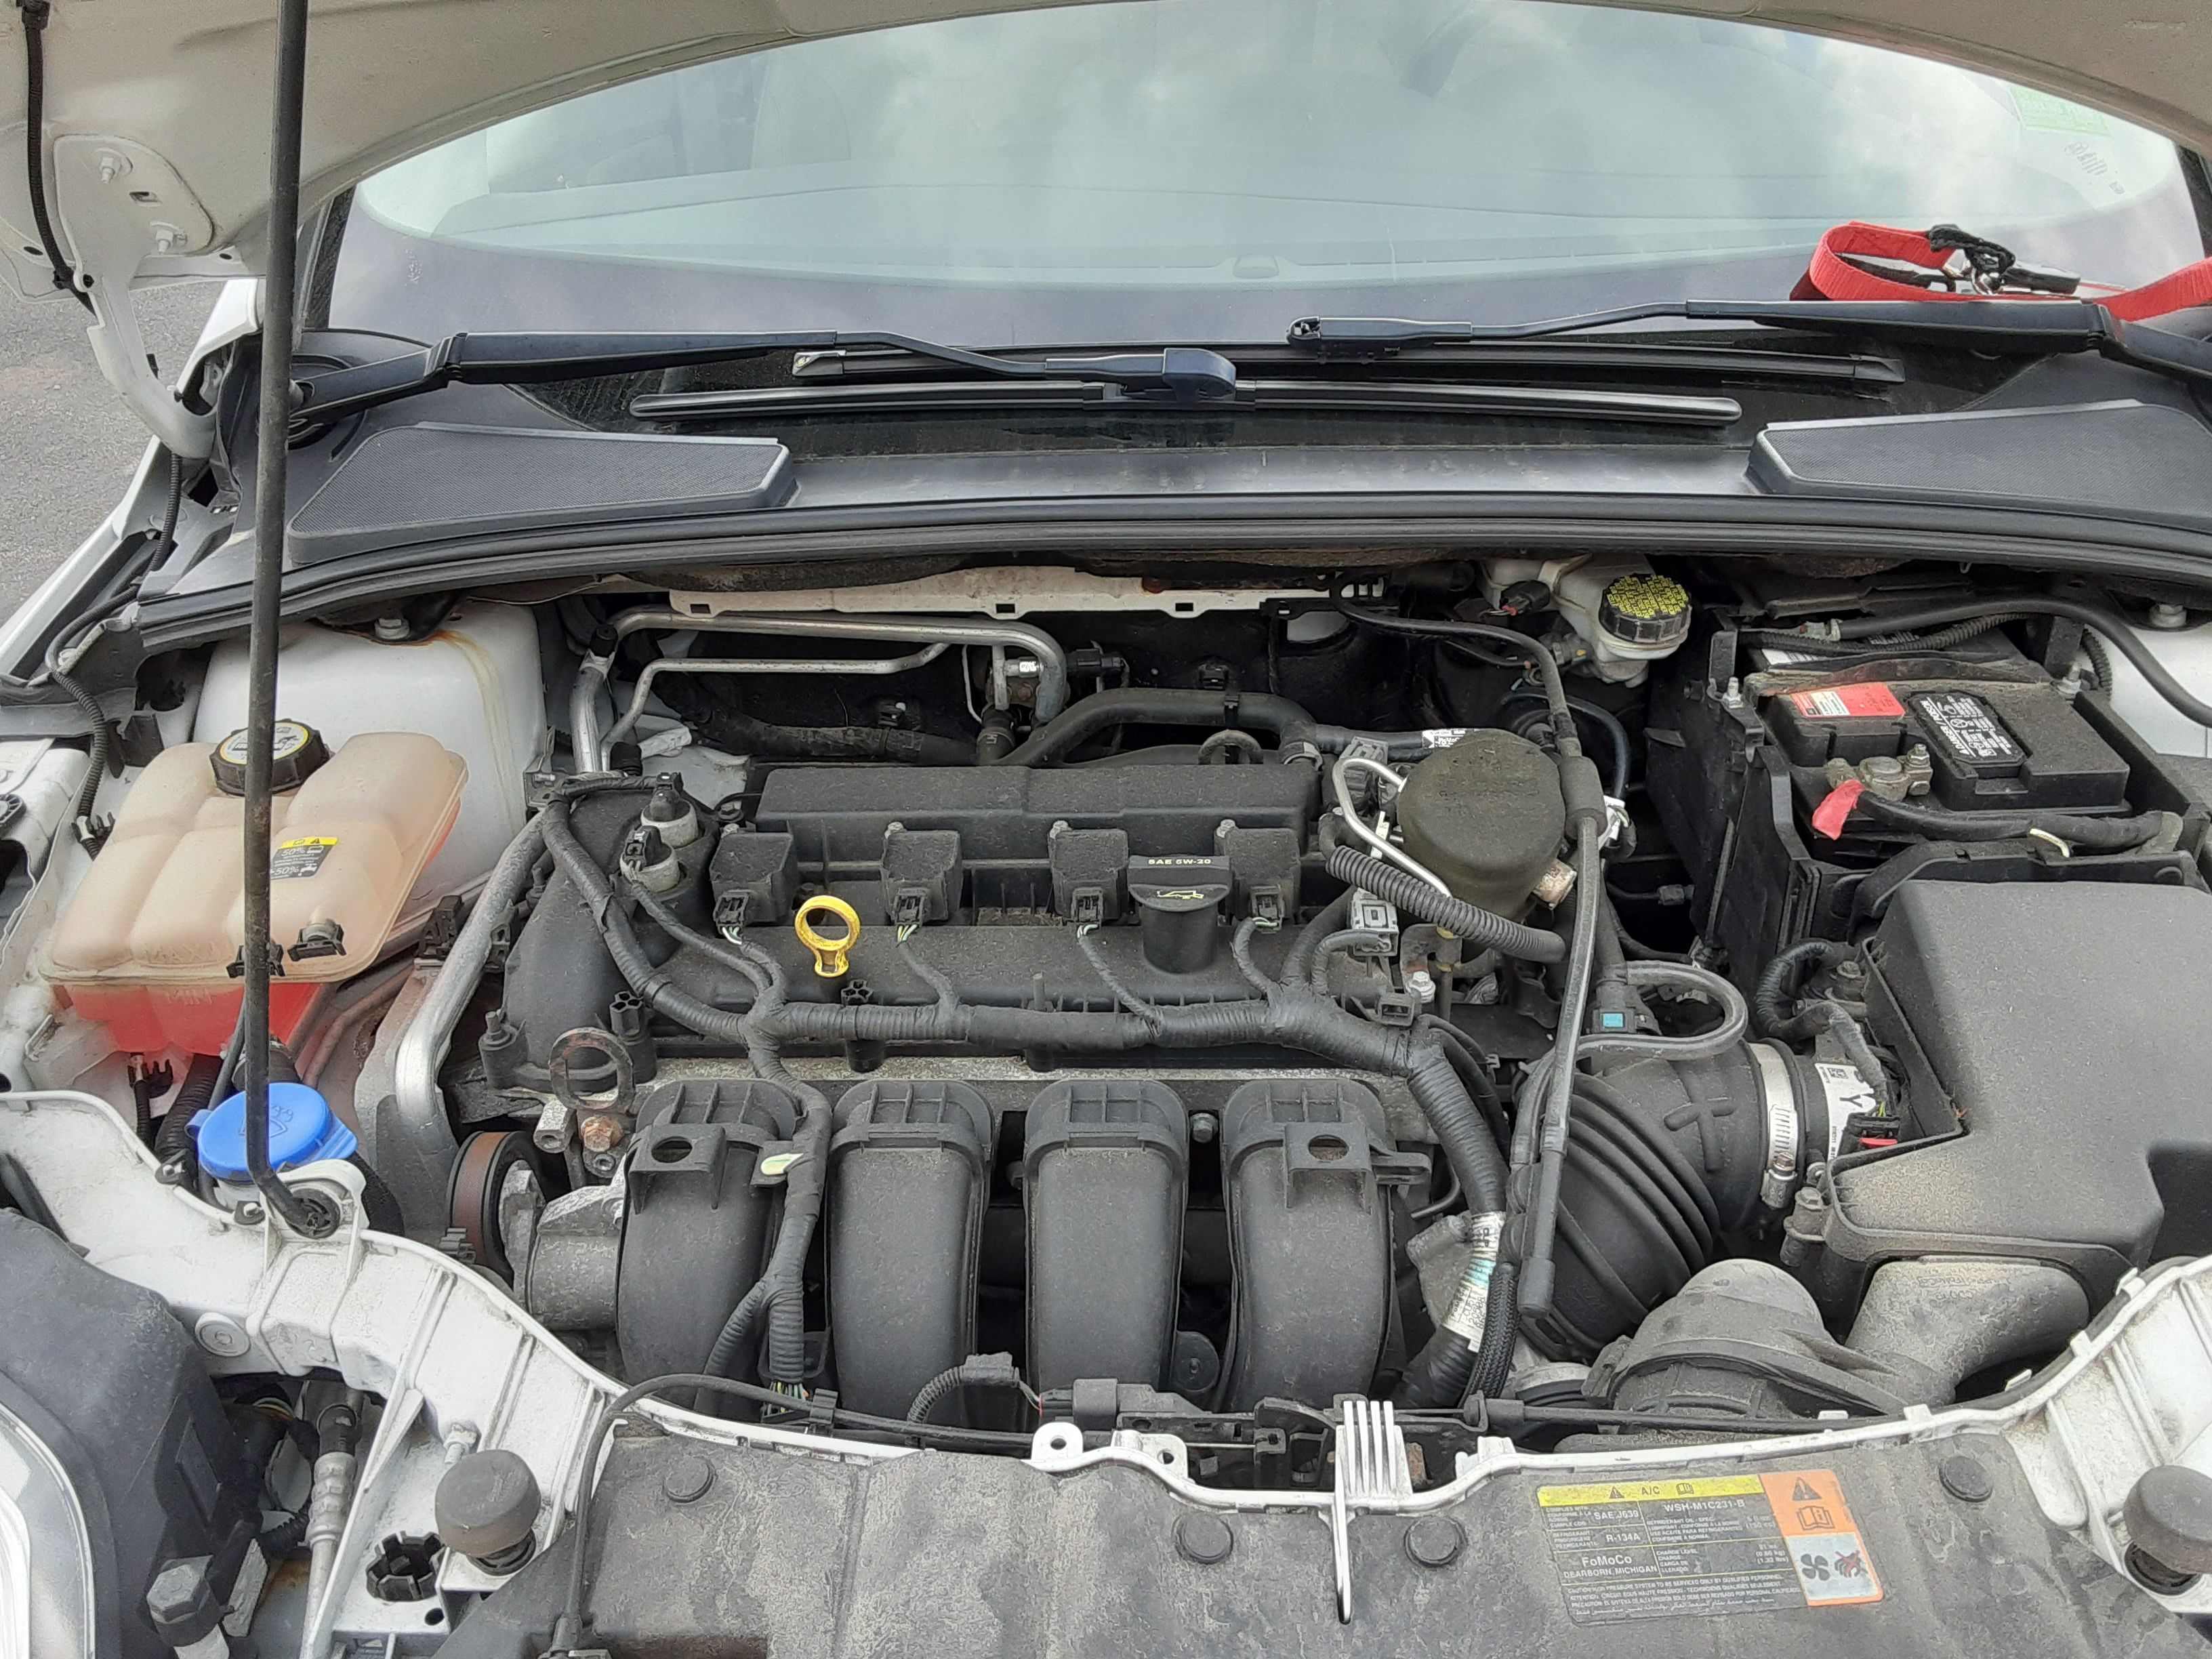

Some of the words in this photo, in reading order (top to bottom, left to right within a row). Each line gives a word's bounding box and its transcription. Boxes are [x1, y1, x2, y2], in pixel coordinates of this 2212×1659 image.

[281, 848, 306, 856] 50%
[1641, 1486, 1660, 1495] A/C
[1664, 1500, 1745, 1512] WSH-M1C231-B
[1594, 1511, 1614, 1520] SAE
[1605, 1533, 1641, 1542] R-134A
[1582, 1555, 1633, 1567] FoMoCo
[1615, 1565, 1658, 1574] MICHIGAN
